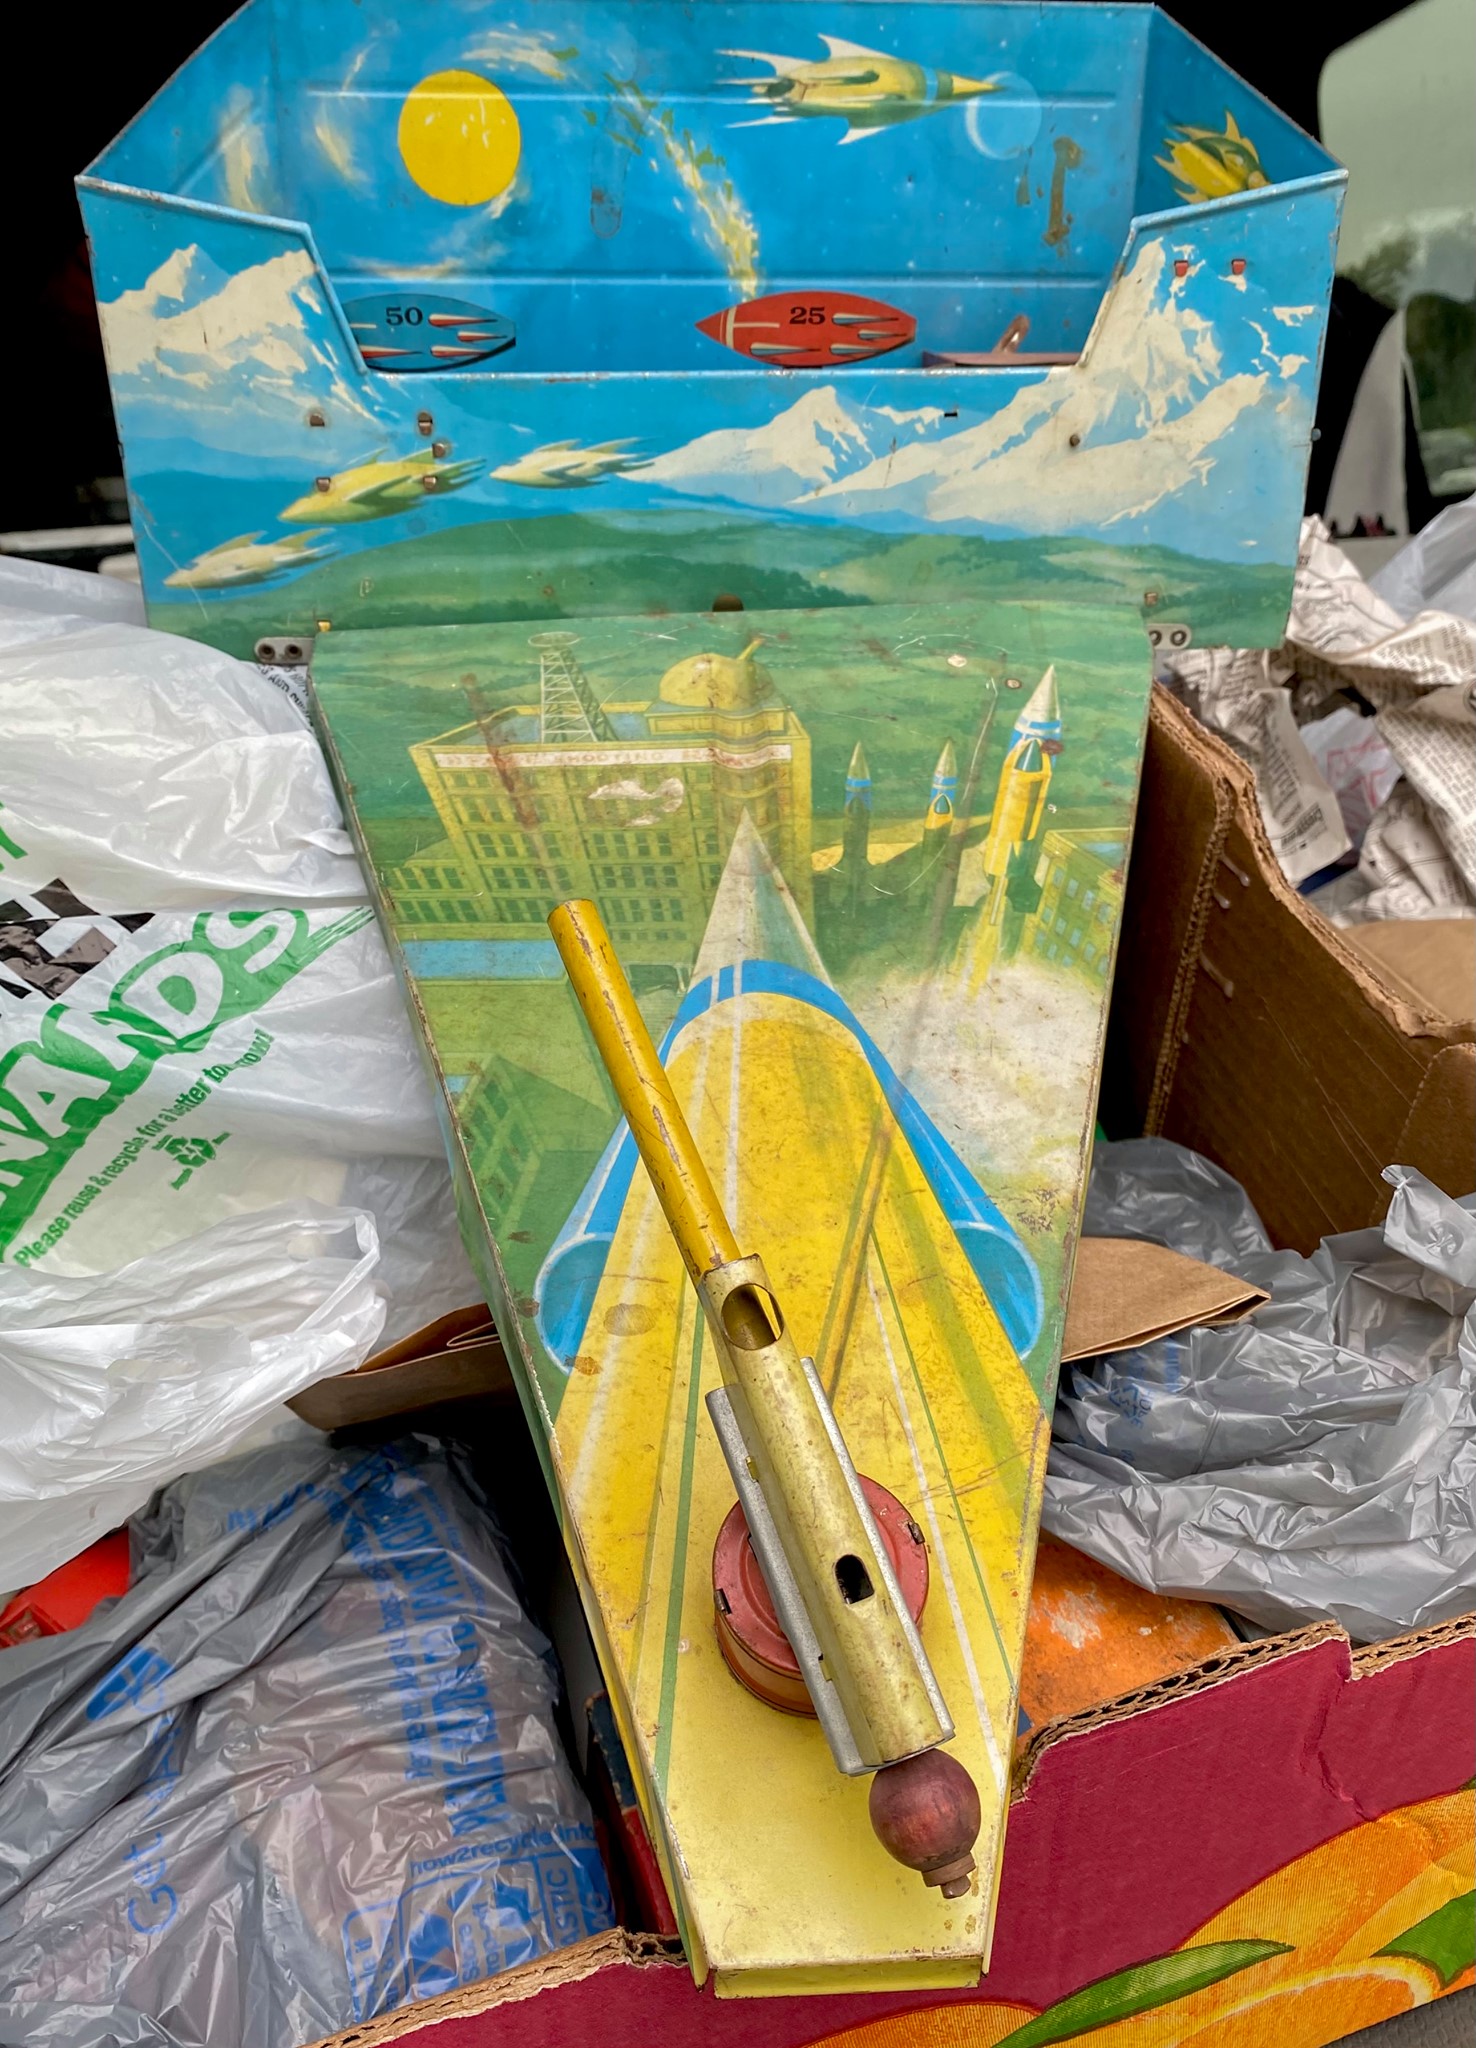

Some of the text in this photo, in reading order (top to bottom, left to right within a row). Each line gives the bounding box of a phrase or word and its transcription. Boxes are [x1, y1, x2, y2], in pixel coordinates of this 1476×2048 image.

[386, 306, 423, 326] 50
[789, 306, 826, 325] 25
[0, 908, 303, 1206] NARDS
[161, 1077, 212, 1117] better
[136, 1119, 168, 1138] for
[158, 1113, 178, 1123] a
[101, 1136, 149, 1178] recycle
[89, 1175, 112, 1187] &
[62, 1184, 103, 1220] reuse
[13, 1216, 71, 1268] Please
[122, 1831, 178, 1935] Get
[546, 1867, 581, 1946] ASTIC
[471, 1900, 500, 1977] rop-off
